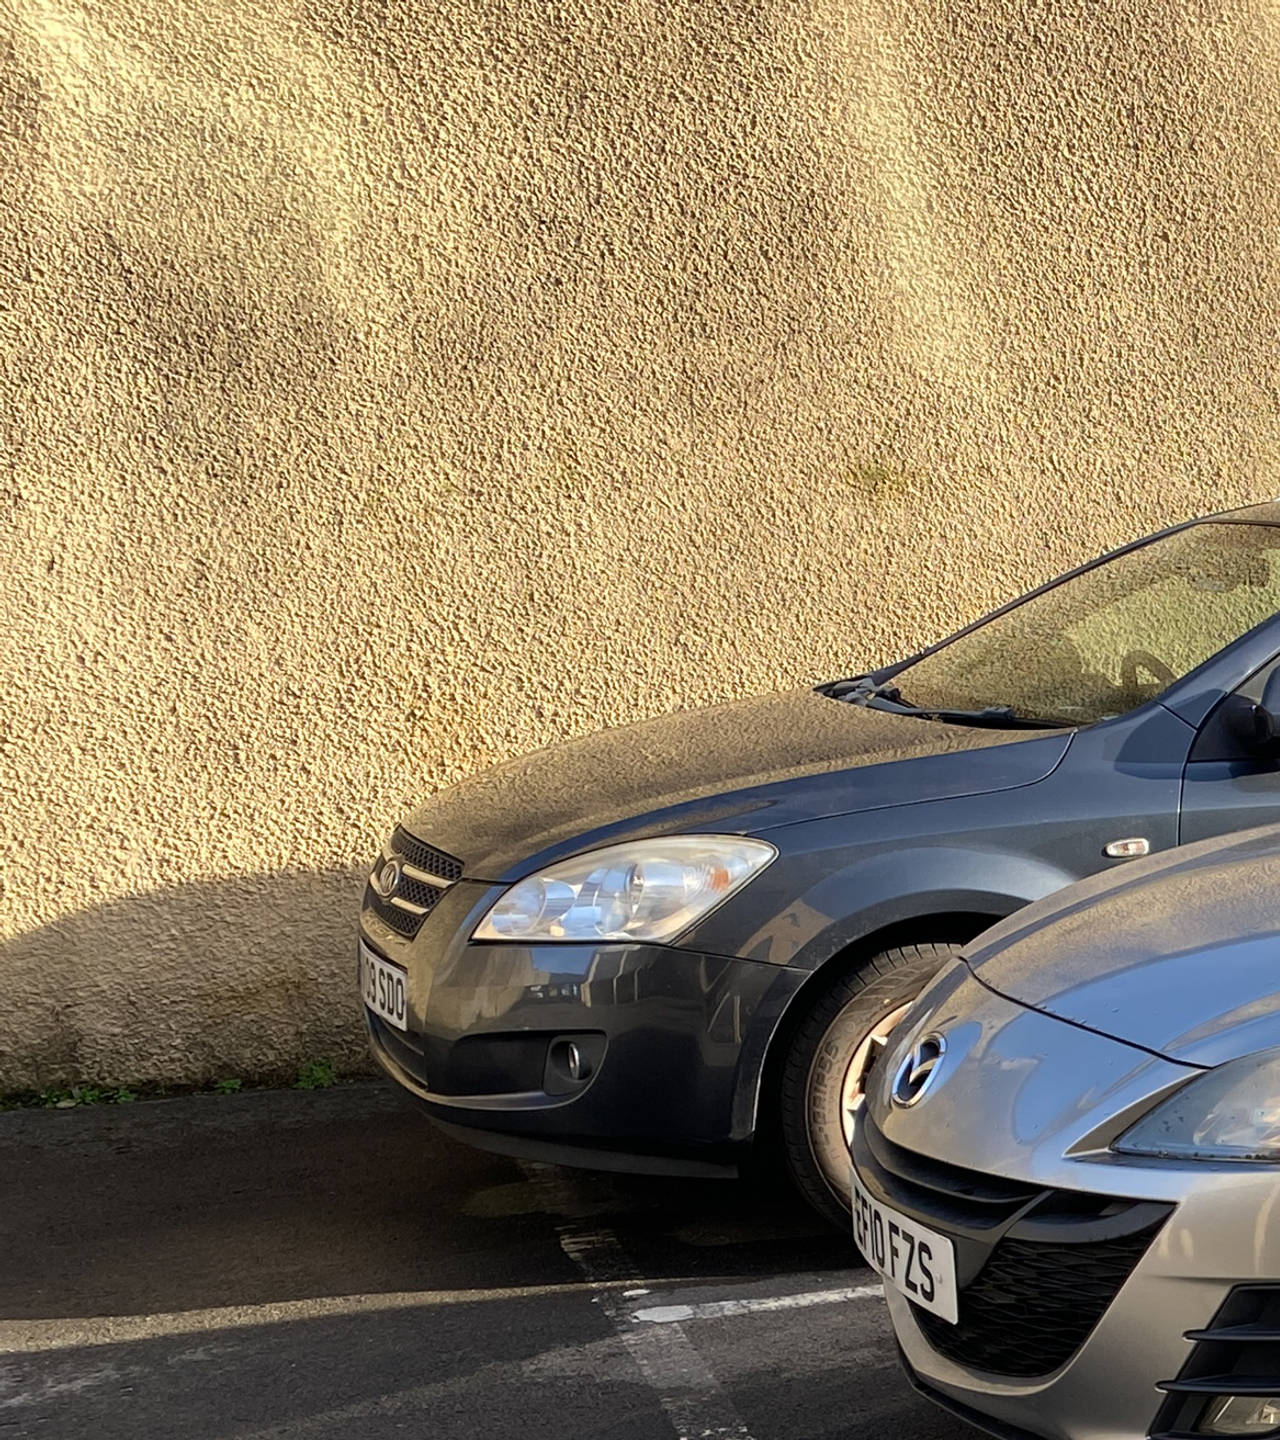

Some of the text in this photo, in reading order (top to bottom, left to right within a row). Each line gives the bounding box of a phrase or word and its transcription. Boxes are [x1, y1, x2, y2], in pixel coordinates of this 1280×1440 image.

[378, 967, 405, 1021] SDO
[854, 1185, 934, 1303] EF10 FZS
